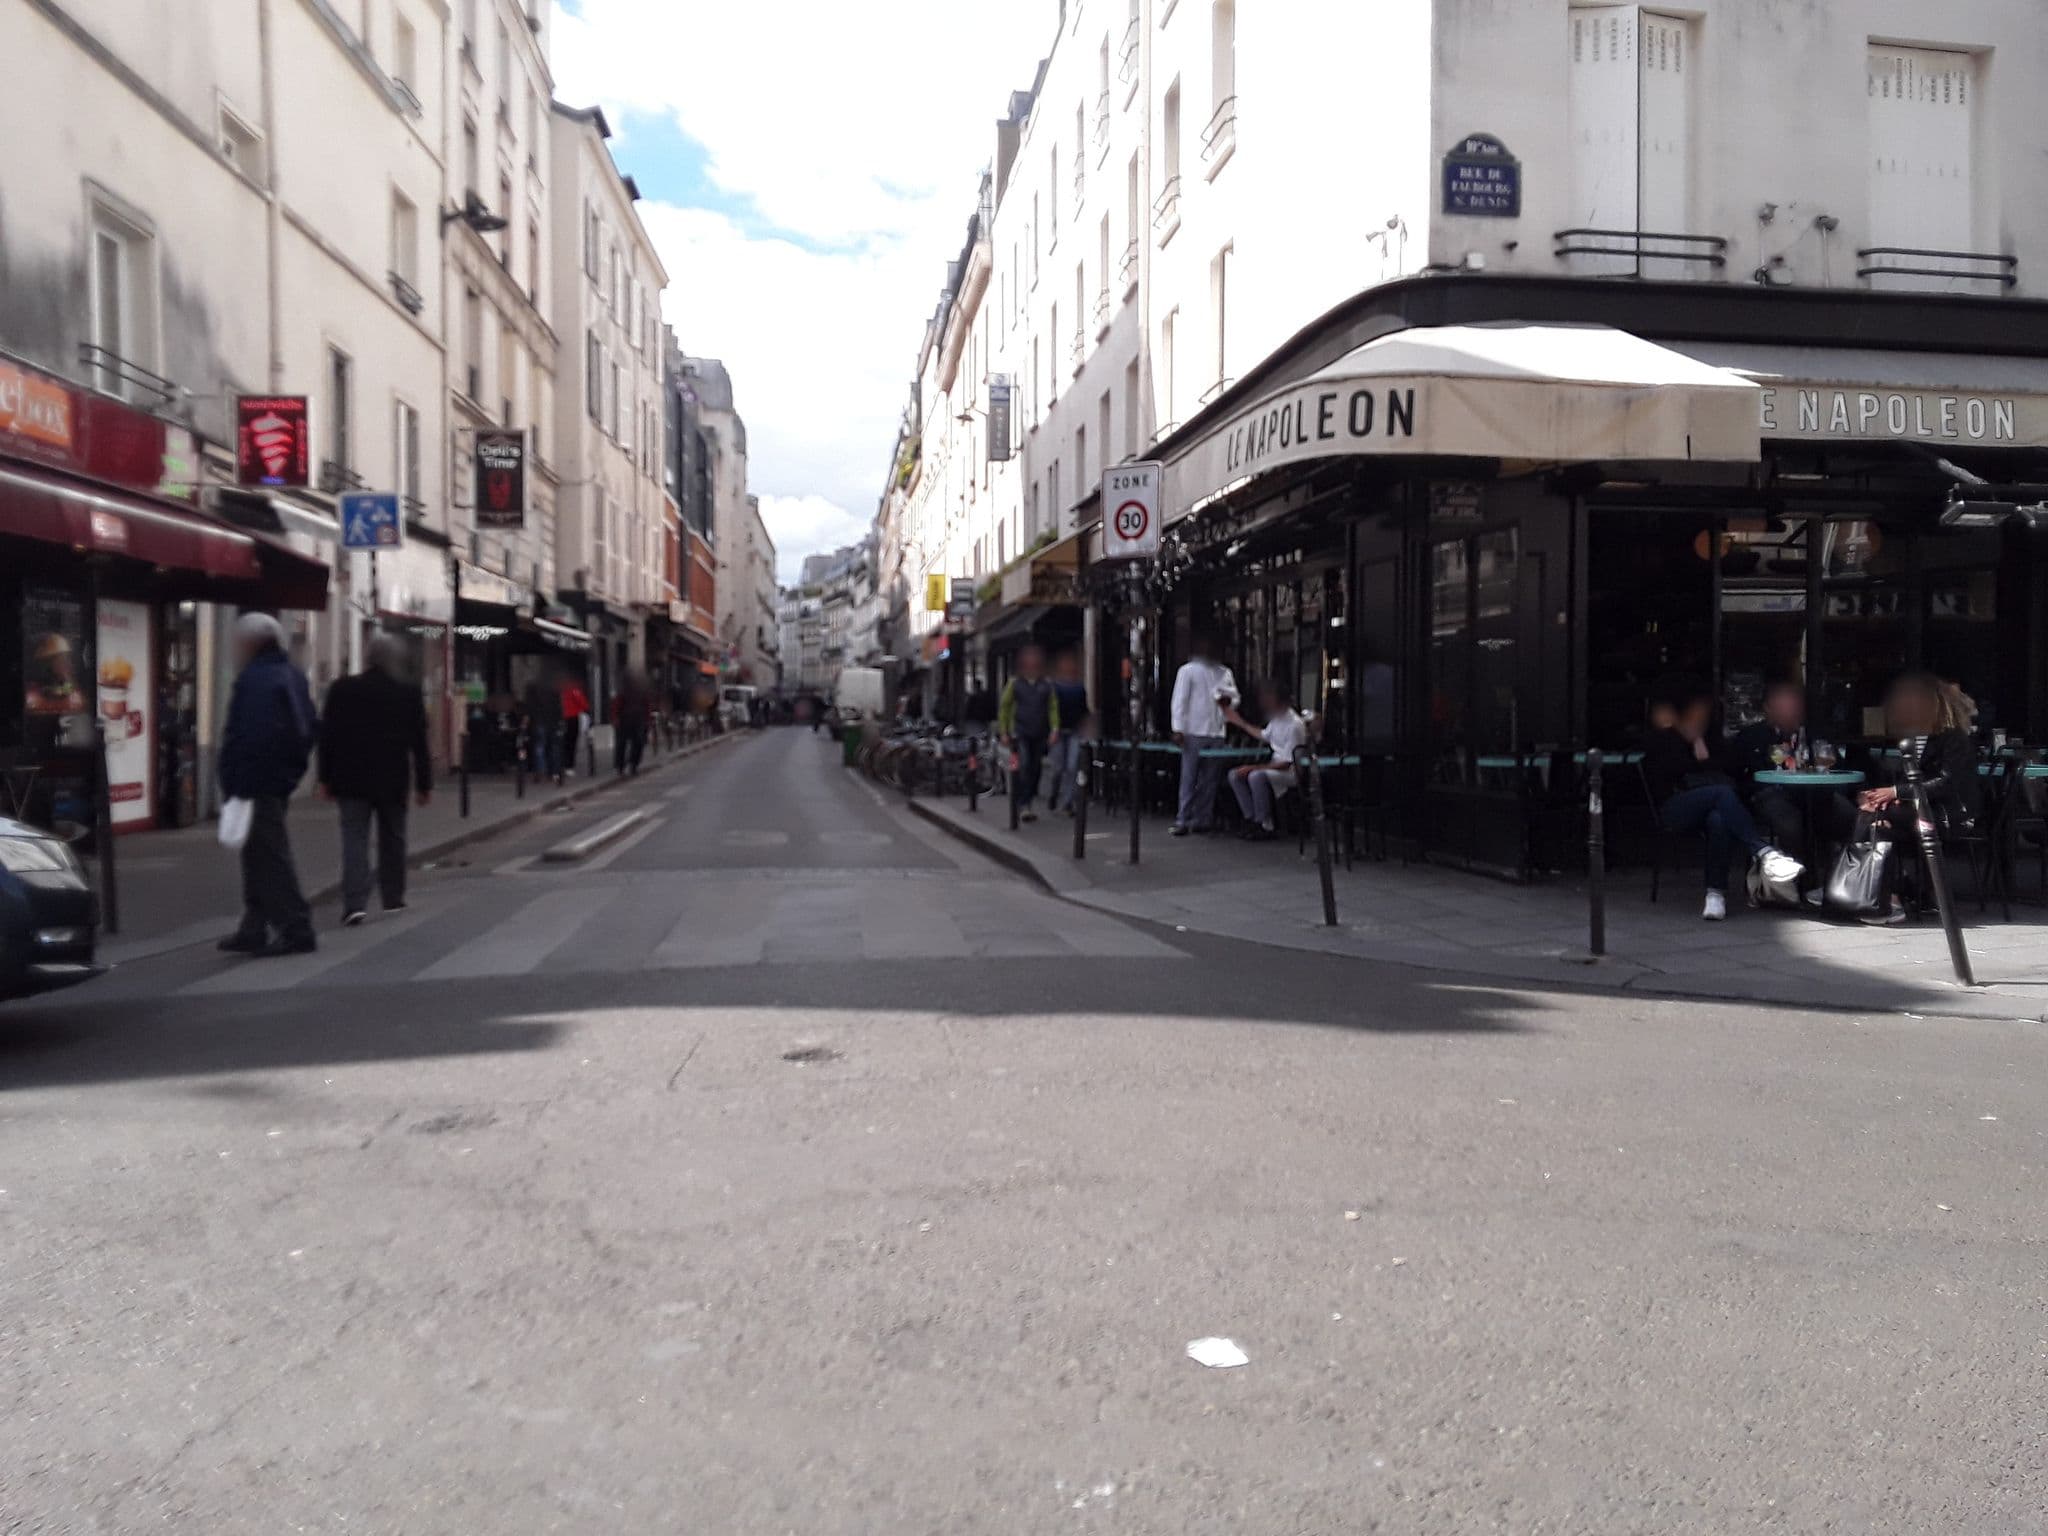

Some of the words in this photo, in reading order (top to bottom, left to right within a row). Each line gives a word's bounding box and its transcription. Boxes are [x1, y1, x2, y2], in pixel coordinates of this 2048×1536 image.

[1226, 426, 1243, 472] LE
[1245, 387, 1415, 463] NAPOLEON
[1760, 387, 1777, 430] E
[1798, 389, 2016, 440] NAPOLEON
[1112, 474, 1150, 490] ZONE
[1121, 512, 1142, 530] 30
